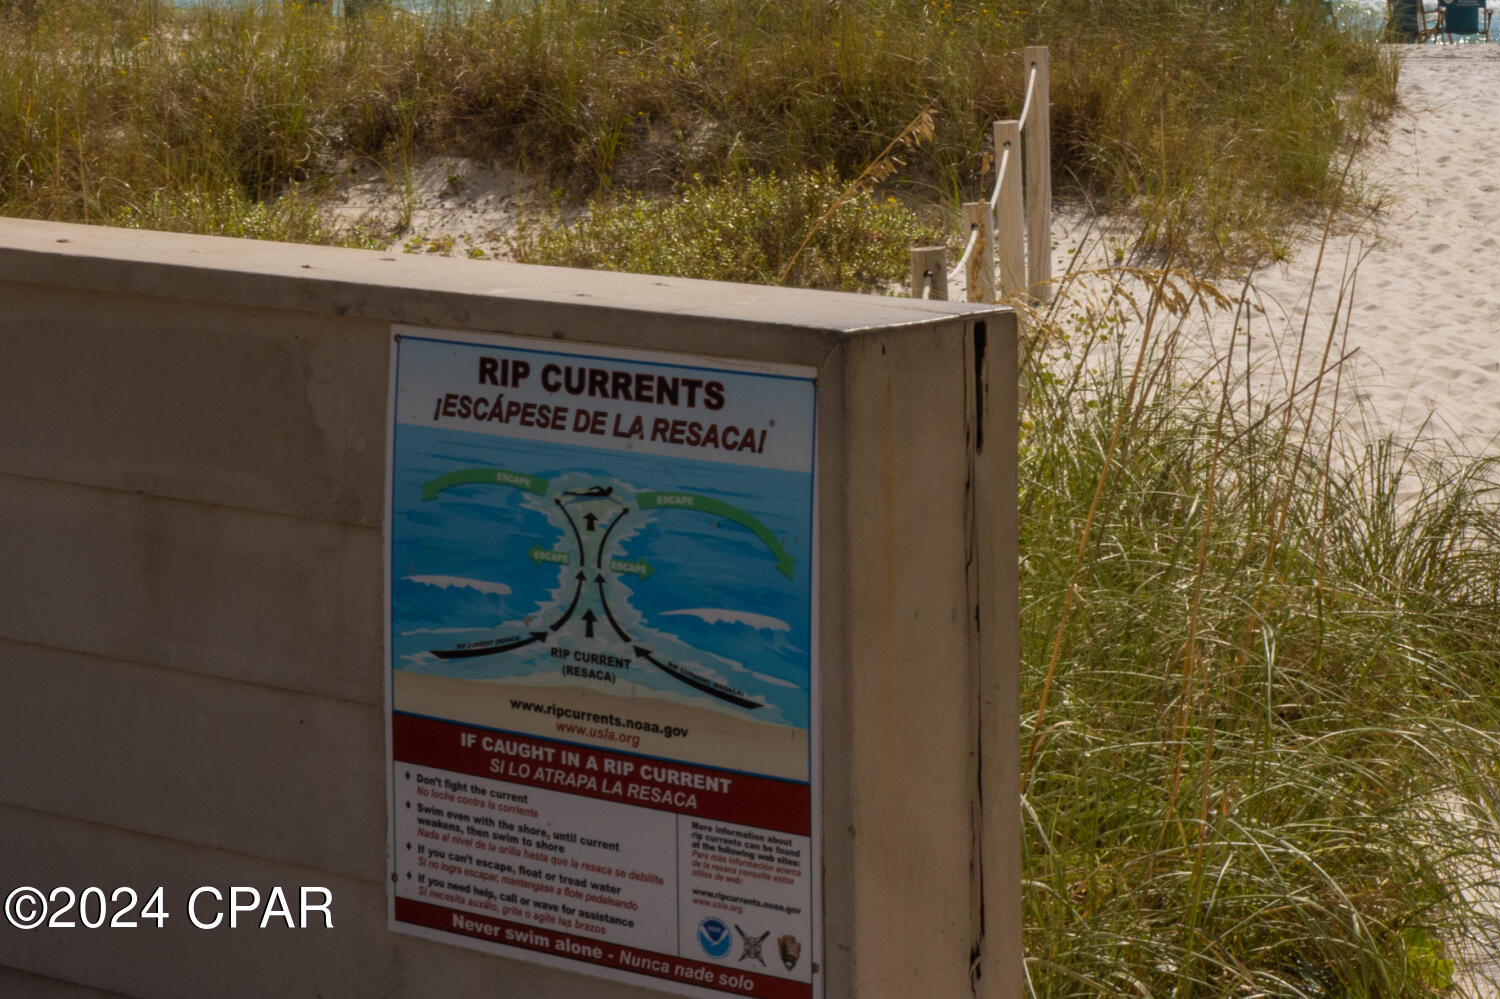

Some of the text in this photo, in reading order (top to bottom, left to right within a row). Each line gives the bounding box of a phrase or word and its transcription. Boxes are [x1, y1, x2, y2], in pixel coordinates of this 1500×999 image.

[478, 356, 726, 411] RIP CURRENTS
[433, 393, 768, 454] ¡ESCÁPESE DE LA RESACA!
[497, 472, 531, 488] ESCAPE
[657, 495, 694, 506] ESCAPE
[533, 550, 570, 564] ESCAPE
[610, 561, 647, 575] ESCAPE
[550, 647, 632, 670] RIP CURRENT
[562, 664, 616, 685] (RESACA)
[509, 699, 689, 739] www.ripcurrents.noaa.gov
[556, 722, 641, 749] www.usla.org
[461, 732, 732, 794] IF CAUGHT IN A RIP CURRENT
[444, 778, 468, 793] fight
[469, 784, 488, 796] the
[489, 789, 529, 804] current
[489, 758, 697, 809] SI LO ATRAPA LA RESACA
[416, 785, 539, 819] No luche contra la corriente
[416, 802, 444, 817] Swim
[446, 810, 471, 823] even
[472, 815, 496, 828] with
[498, 819, 515, 832] the
[552, 832, 577, 844] until
[579, 837, 620, 852] current
[466, 825, 490, 839] then
[492, 832, 520, 845] swim
[521, 836, 533, 847] to
[535, 839, 566, 854] shore
[691, 821, 793, 847] More information about
[691, 831, 801, 858] rip currents can be found
[417, 843, 425, 854] If
[427, 848, 446, 859] you
[518, 864, 542, 879] float
[544, 872, 557, 881] or
[558, 873, 588, 888] tread
[590, 881, 622, 895] water
[417, 873, 426, 884] If
[427, 877, 445, 889] you
[447, 882, 471, 894] need
[499, 893, 518, 904] call
[519, 897, 531, 906] or
[532, 900, 560, 913] wave
[561, 903, 576, 916] for
[578, 909, 635, 929] assistance
[452, 913, 501, 937] Never
[505, 928, 550, 948] swim
[555, 937, 603, 959] alone
[619, 949, 670, 974] Nunca
[674, 965, 715, 983] nade
[718, 973, 754, 991] solo
